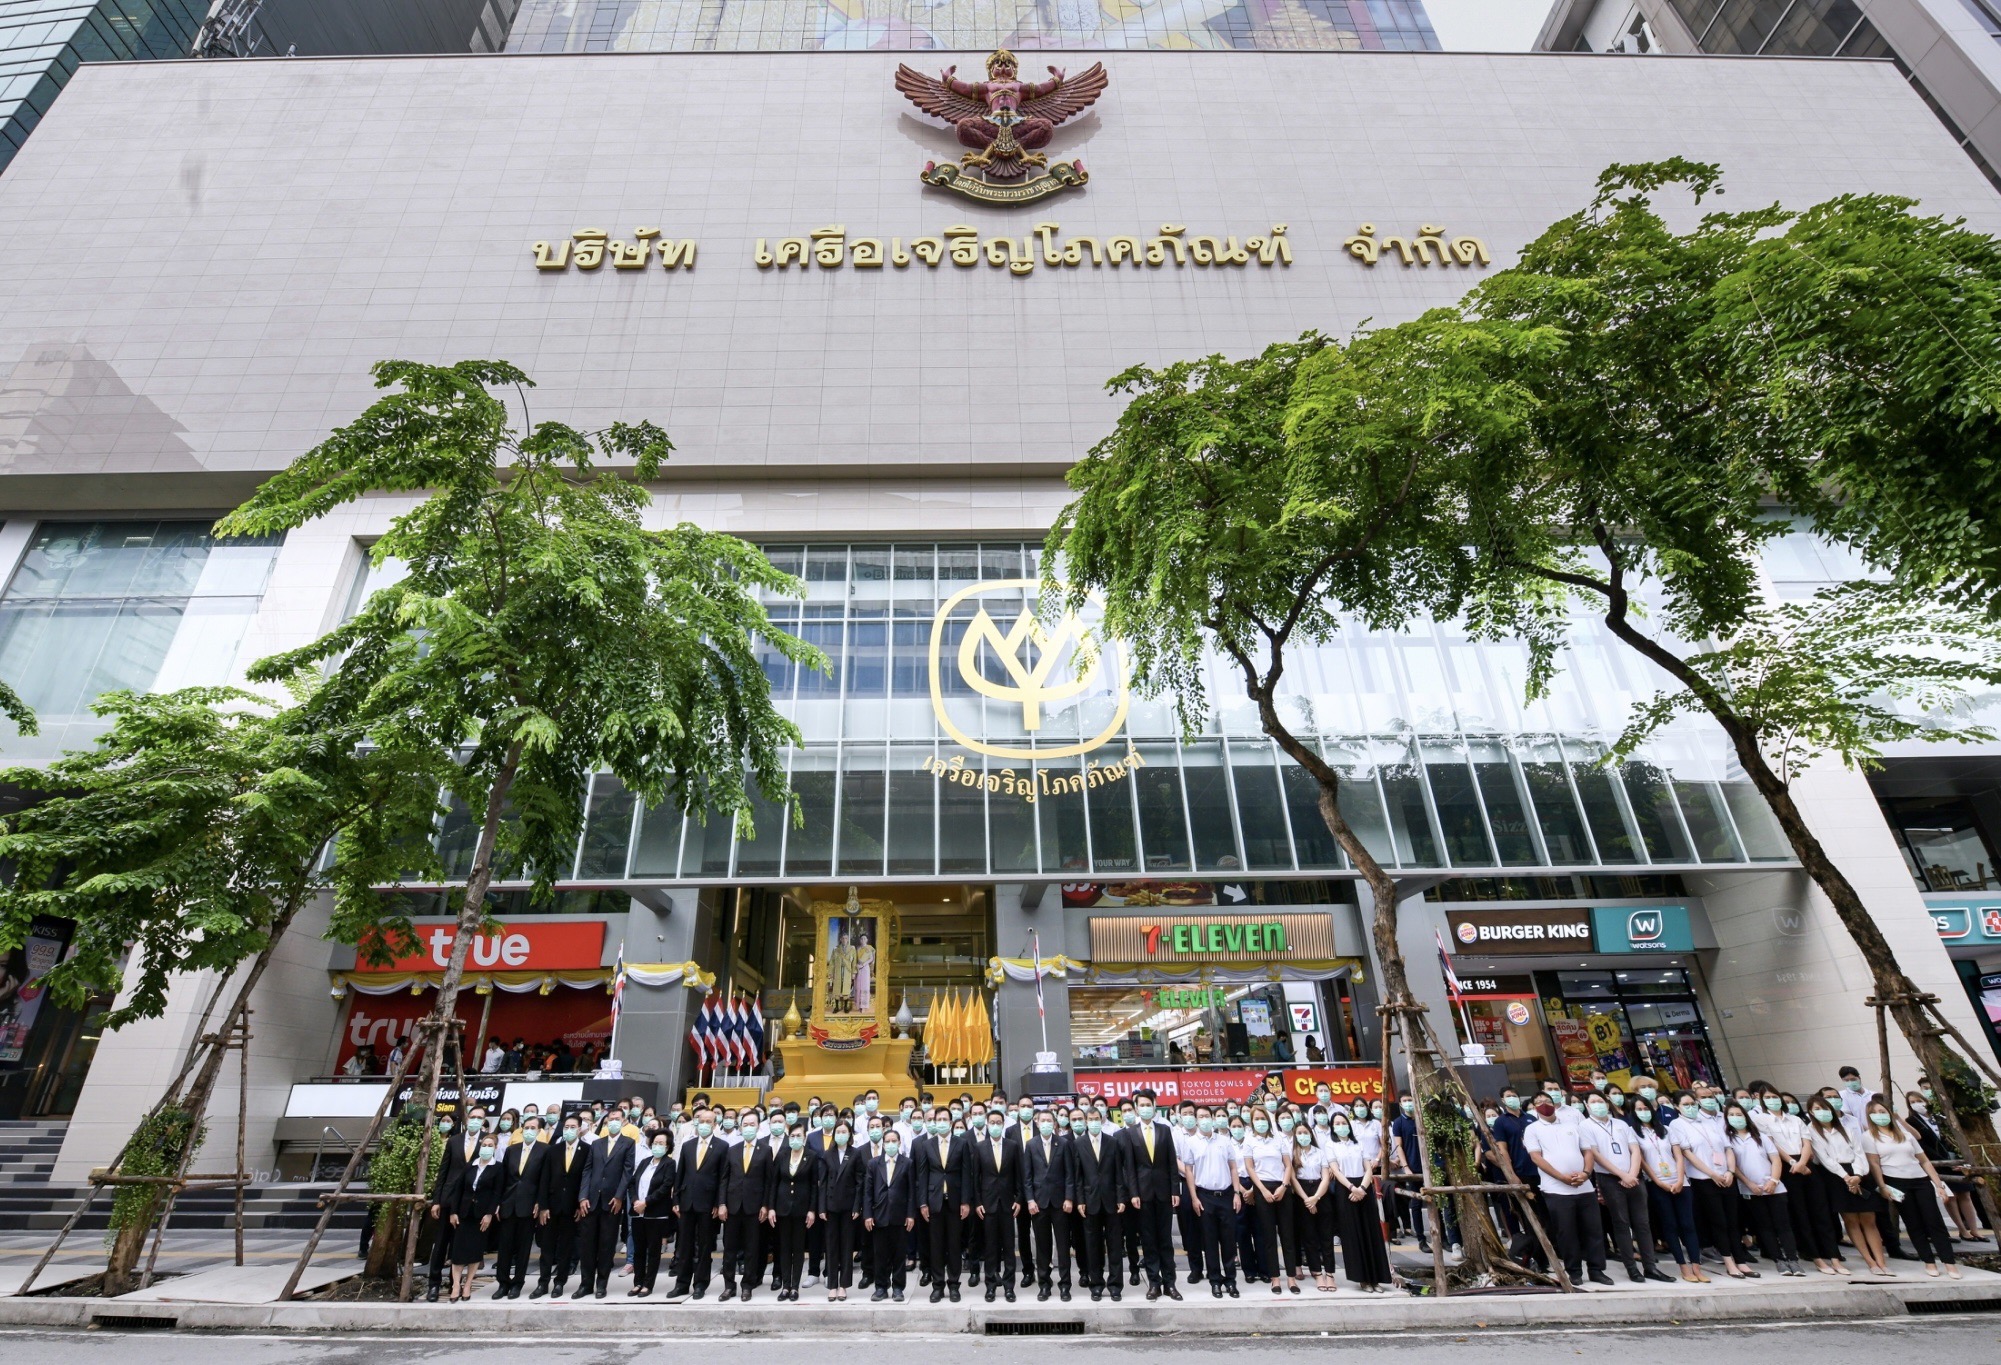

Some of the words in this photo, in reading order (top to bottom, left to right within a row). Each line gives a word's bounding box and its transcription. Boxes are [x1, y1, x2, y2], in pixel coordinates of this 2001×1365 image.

[531, 226, 697, 269] บริษัท
[753, 223, 1292, 275] เครือเจริญโภคภัณฑ์
[1343, 223, 1491, 265] จำกัด
[921, 739, 1147, 803] เครือเจริญโภคภัณฑ์
[1093, 859, 1113, 867] YOUR
[1113, 858, 1131, 867] WAY
[1479, 925, 1545, 940] BURGER
[1547, 923, 1589, 939] KING
[1635, 918, 1655, 932] W
[430, 928, 530, 967] tue
[1475, 980, 1497, 989] 1954
[1182, 1080, 1211, 1088] TOKYO
[1294, 1077, 1384, 1096] Chster's
[436, 1103, 455, 1112] Siam
